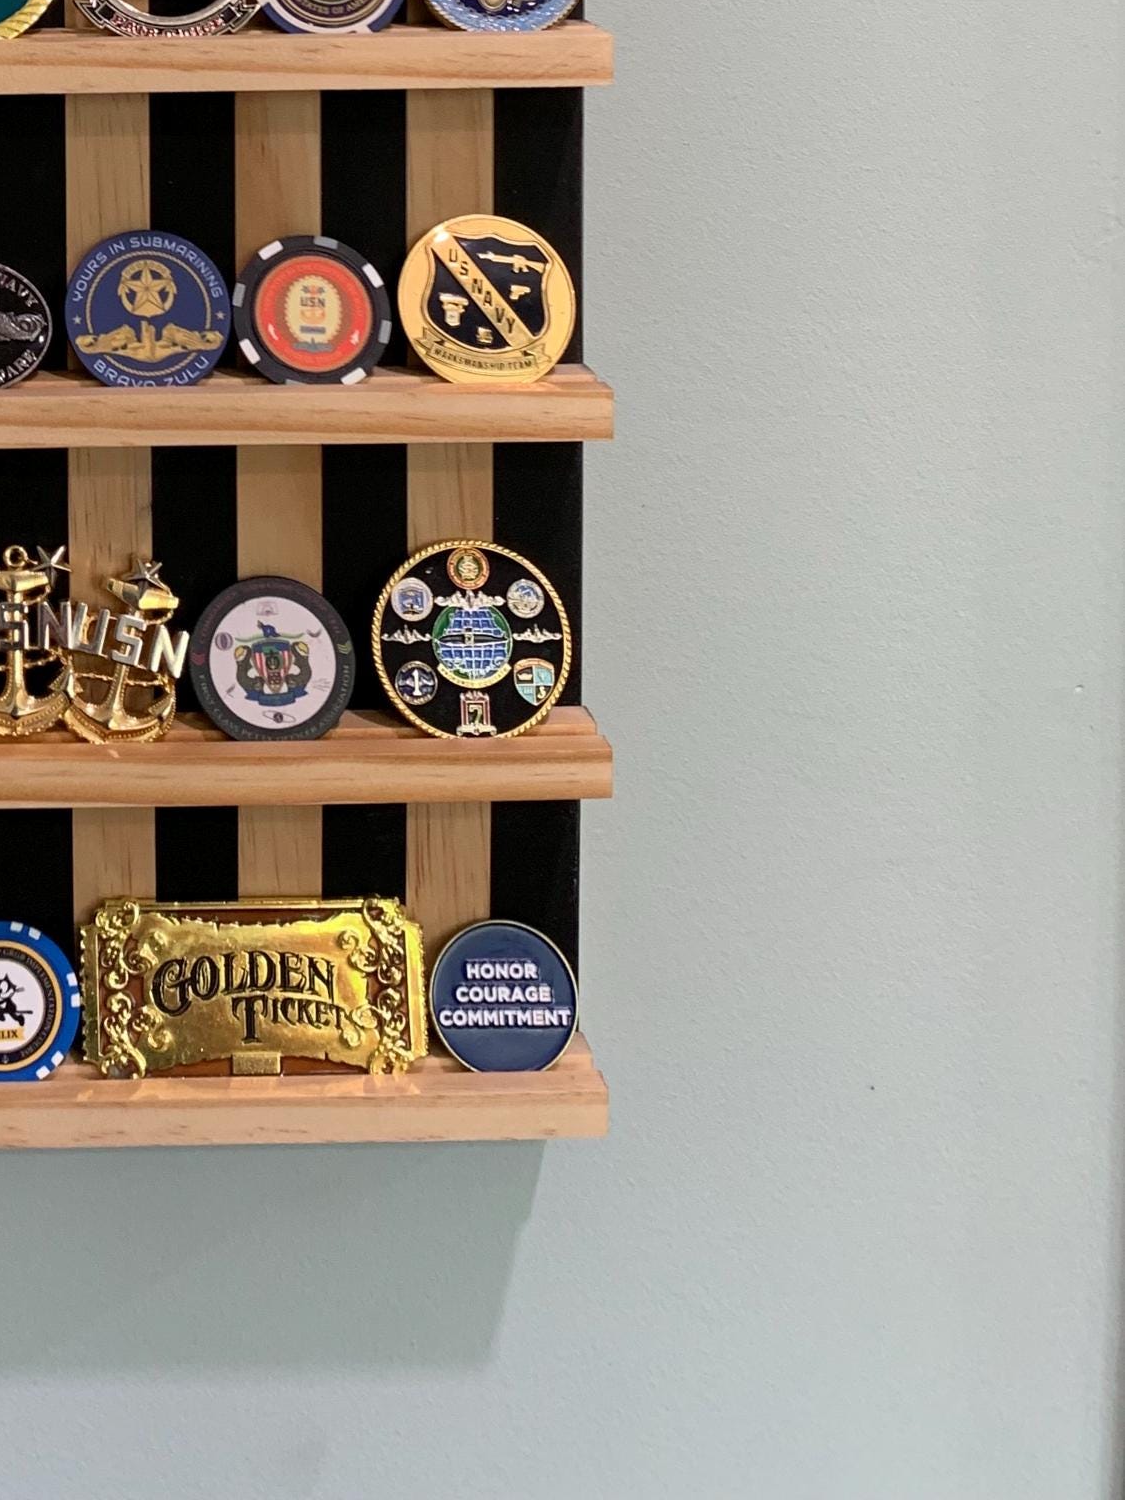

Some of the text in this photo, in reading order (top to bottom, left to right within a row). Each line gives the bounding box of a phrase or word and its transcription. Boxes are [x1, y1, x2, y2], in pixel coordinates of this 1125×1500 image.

[72, 251, 108, 302] YOURS
[108, 241, 126, 256] IN
[129, 236, 224, 299] SUBMARINING
[299, 296, 326, 308] USN
[471, 278, 516, 334] NAVY
[93, 356, 210, 387] BRAVO ZULU
[434, 348, 533, 371] MARKSMANSHIP TEAM
[71, 602, 191, 679] USN
[150, 950, 335, 1016] GOLDEN
[465, 962, 539, 980] HONOR
[454, 985, 553, 1003] COURAGE
[231, 994, 351, 1045] TICKET
[438, 1008, 572, 1027] COMMITMENT
